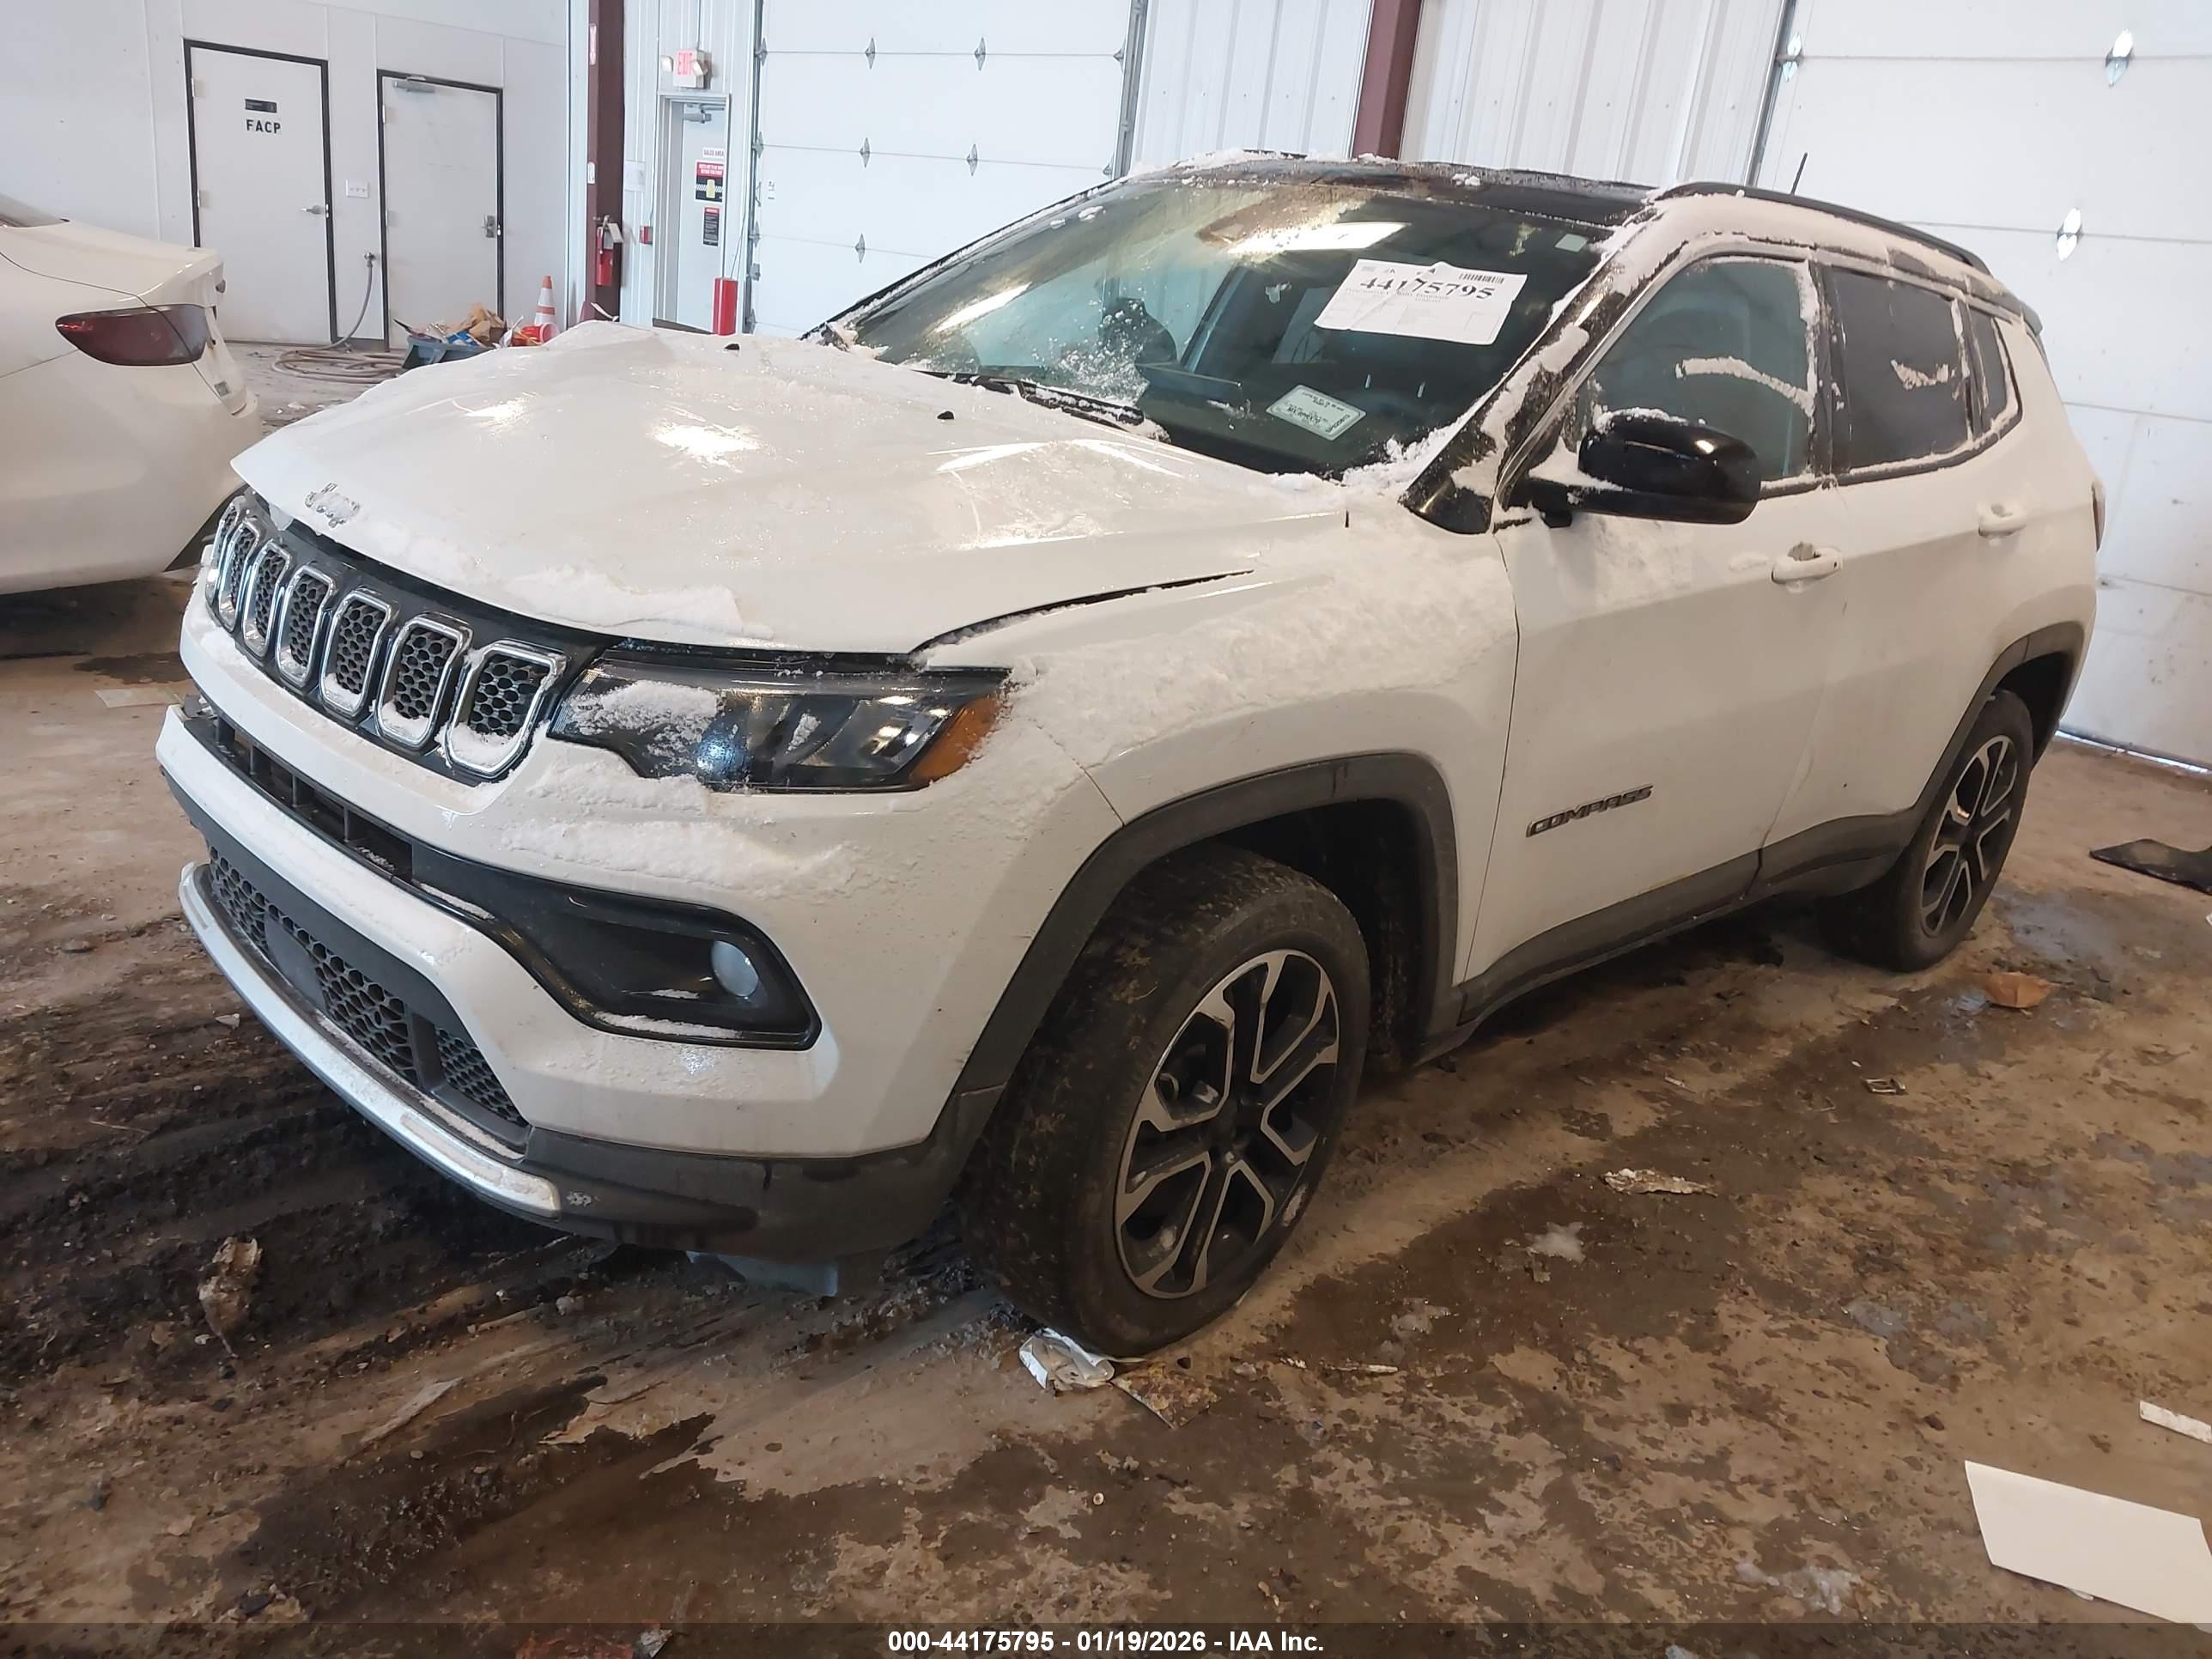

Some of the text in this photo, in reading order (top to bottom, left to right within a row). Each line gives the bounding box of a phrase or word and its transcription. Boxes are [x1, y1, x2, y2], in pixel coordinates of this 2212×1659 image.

[246, 118, 281, 134] FACP
[1360, 276, 1495, 300] 44175795
[1525, 785, 1654, 837] COMPASS
